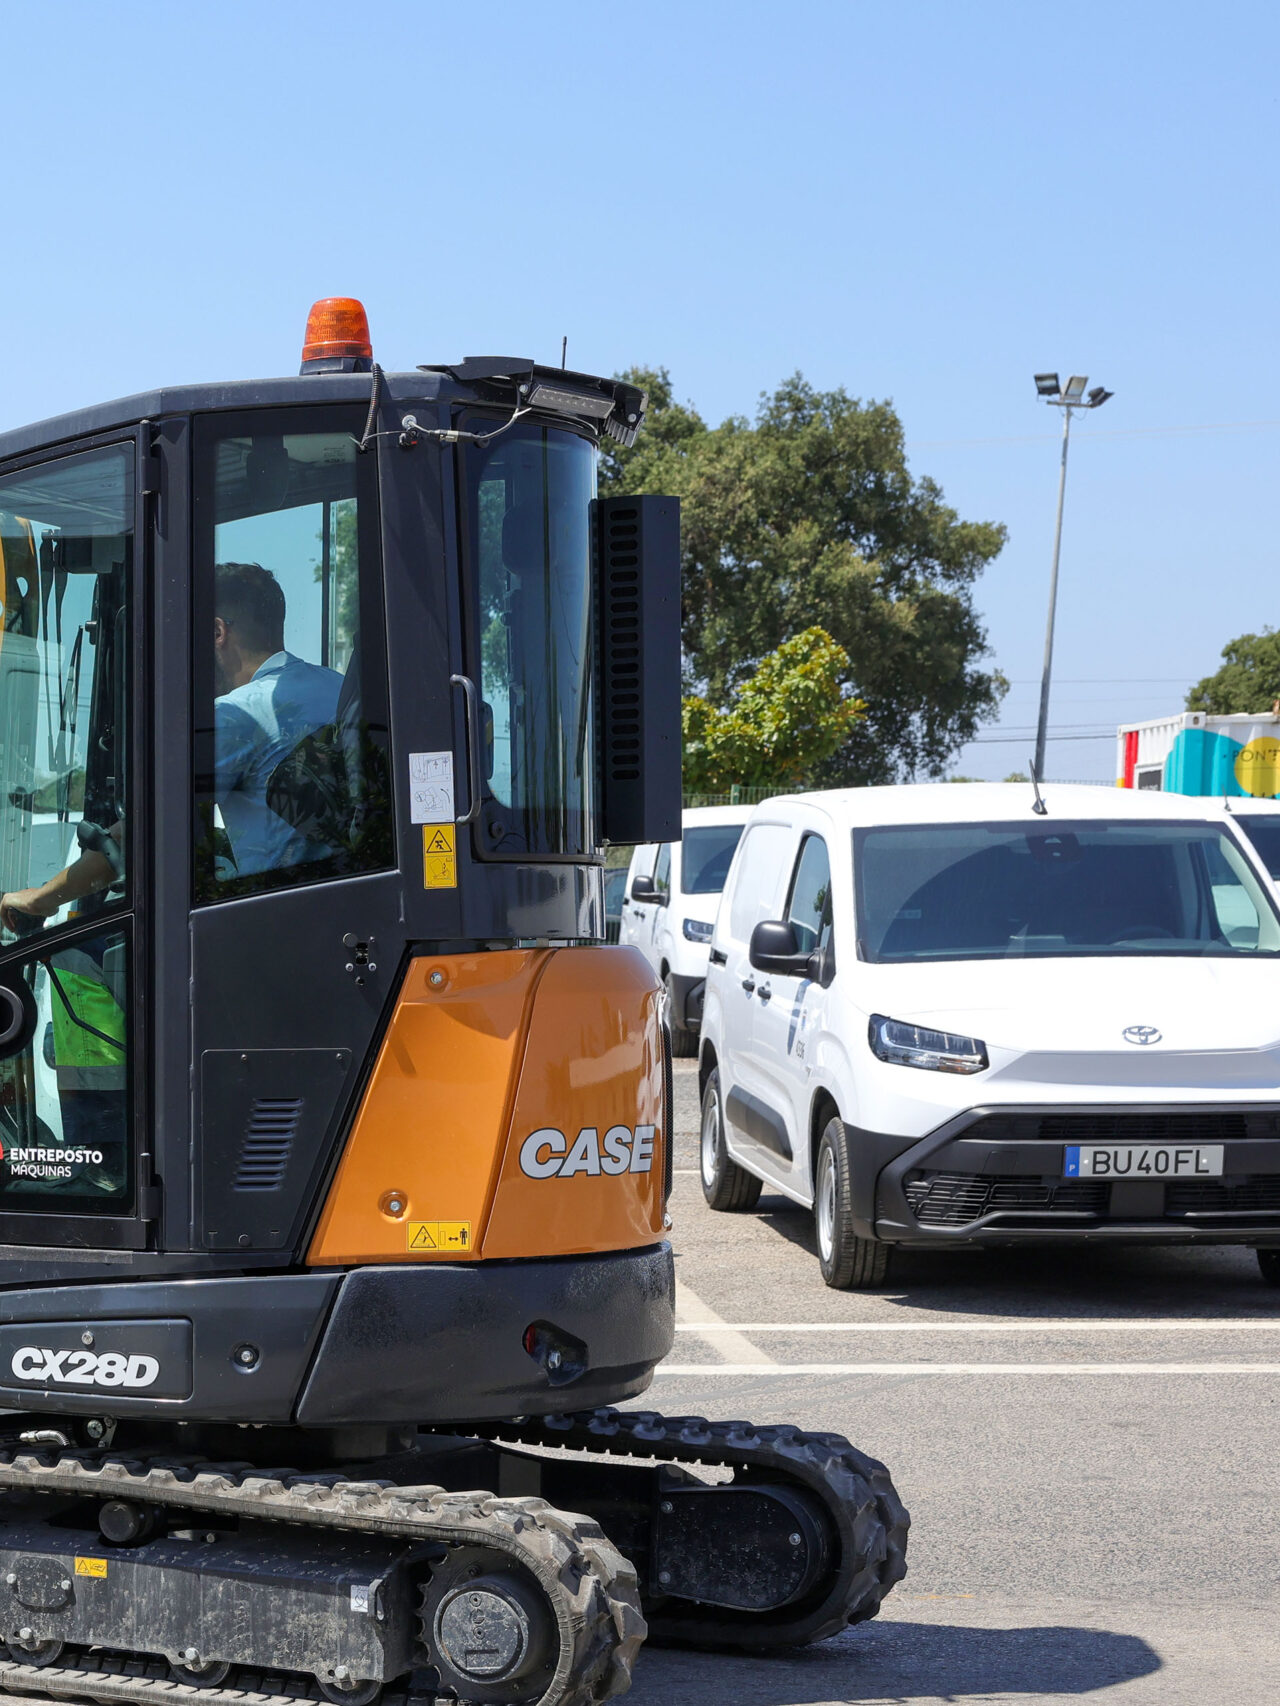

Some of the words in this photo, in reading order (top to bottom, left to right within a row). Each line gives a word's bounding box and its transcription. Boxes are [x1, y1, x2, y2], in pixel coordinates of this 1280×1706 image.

[10, 1148, 103, 1164] ENTREPOSTO
[519, 1125, 656, 1180] CASE
[11, 1161, 72, 1178] MÁQUINAS
[11, 1346, 160, 1387] CX28D
